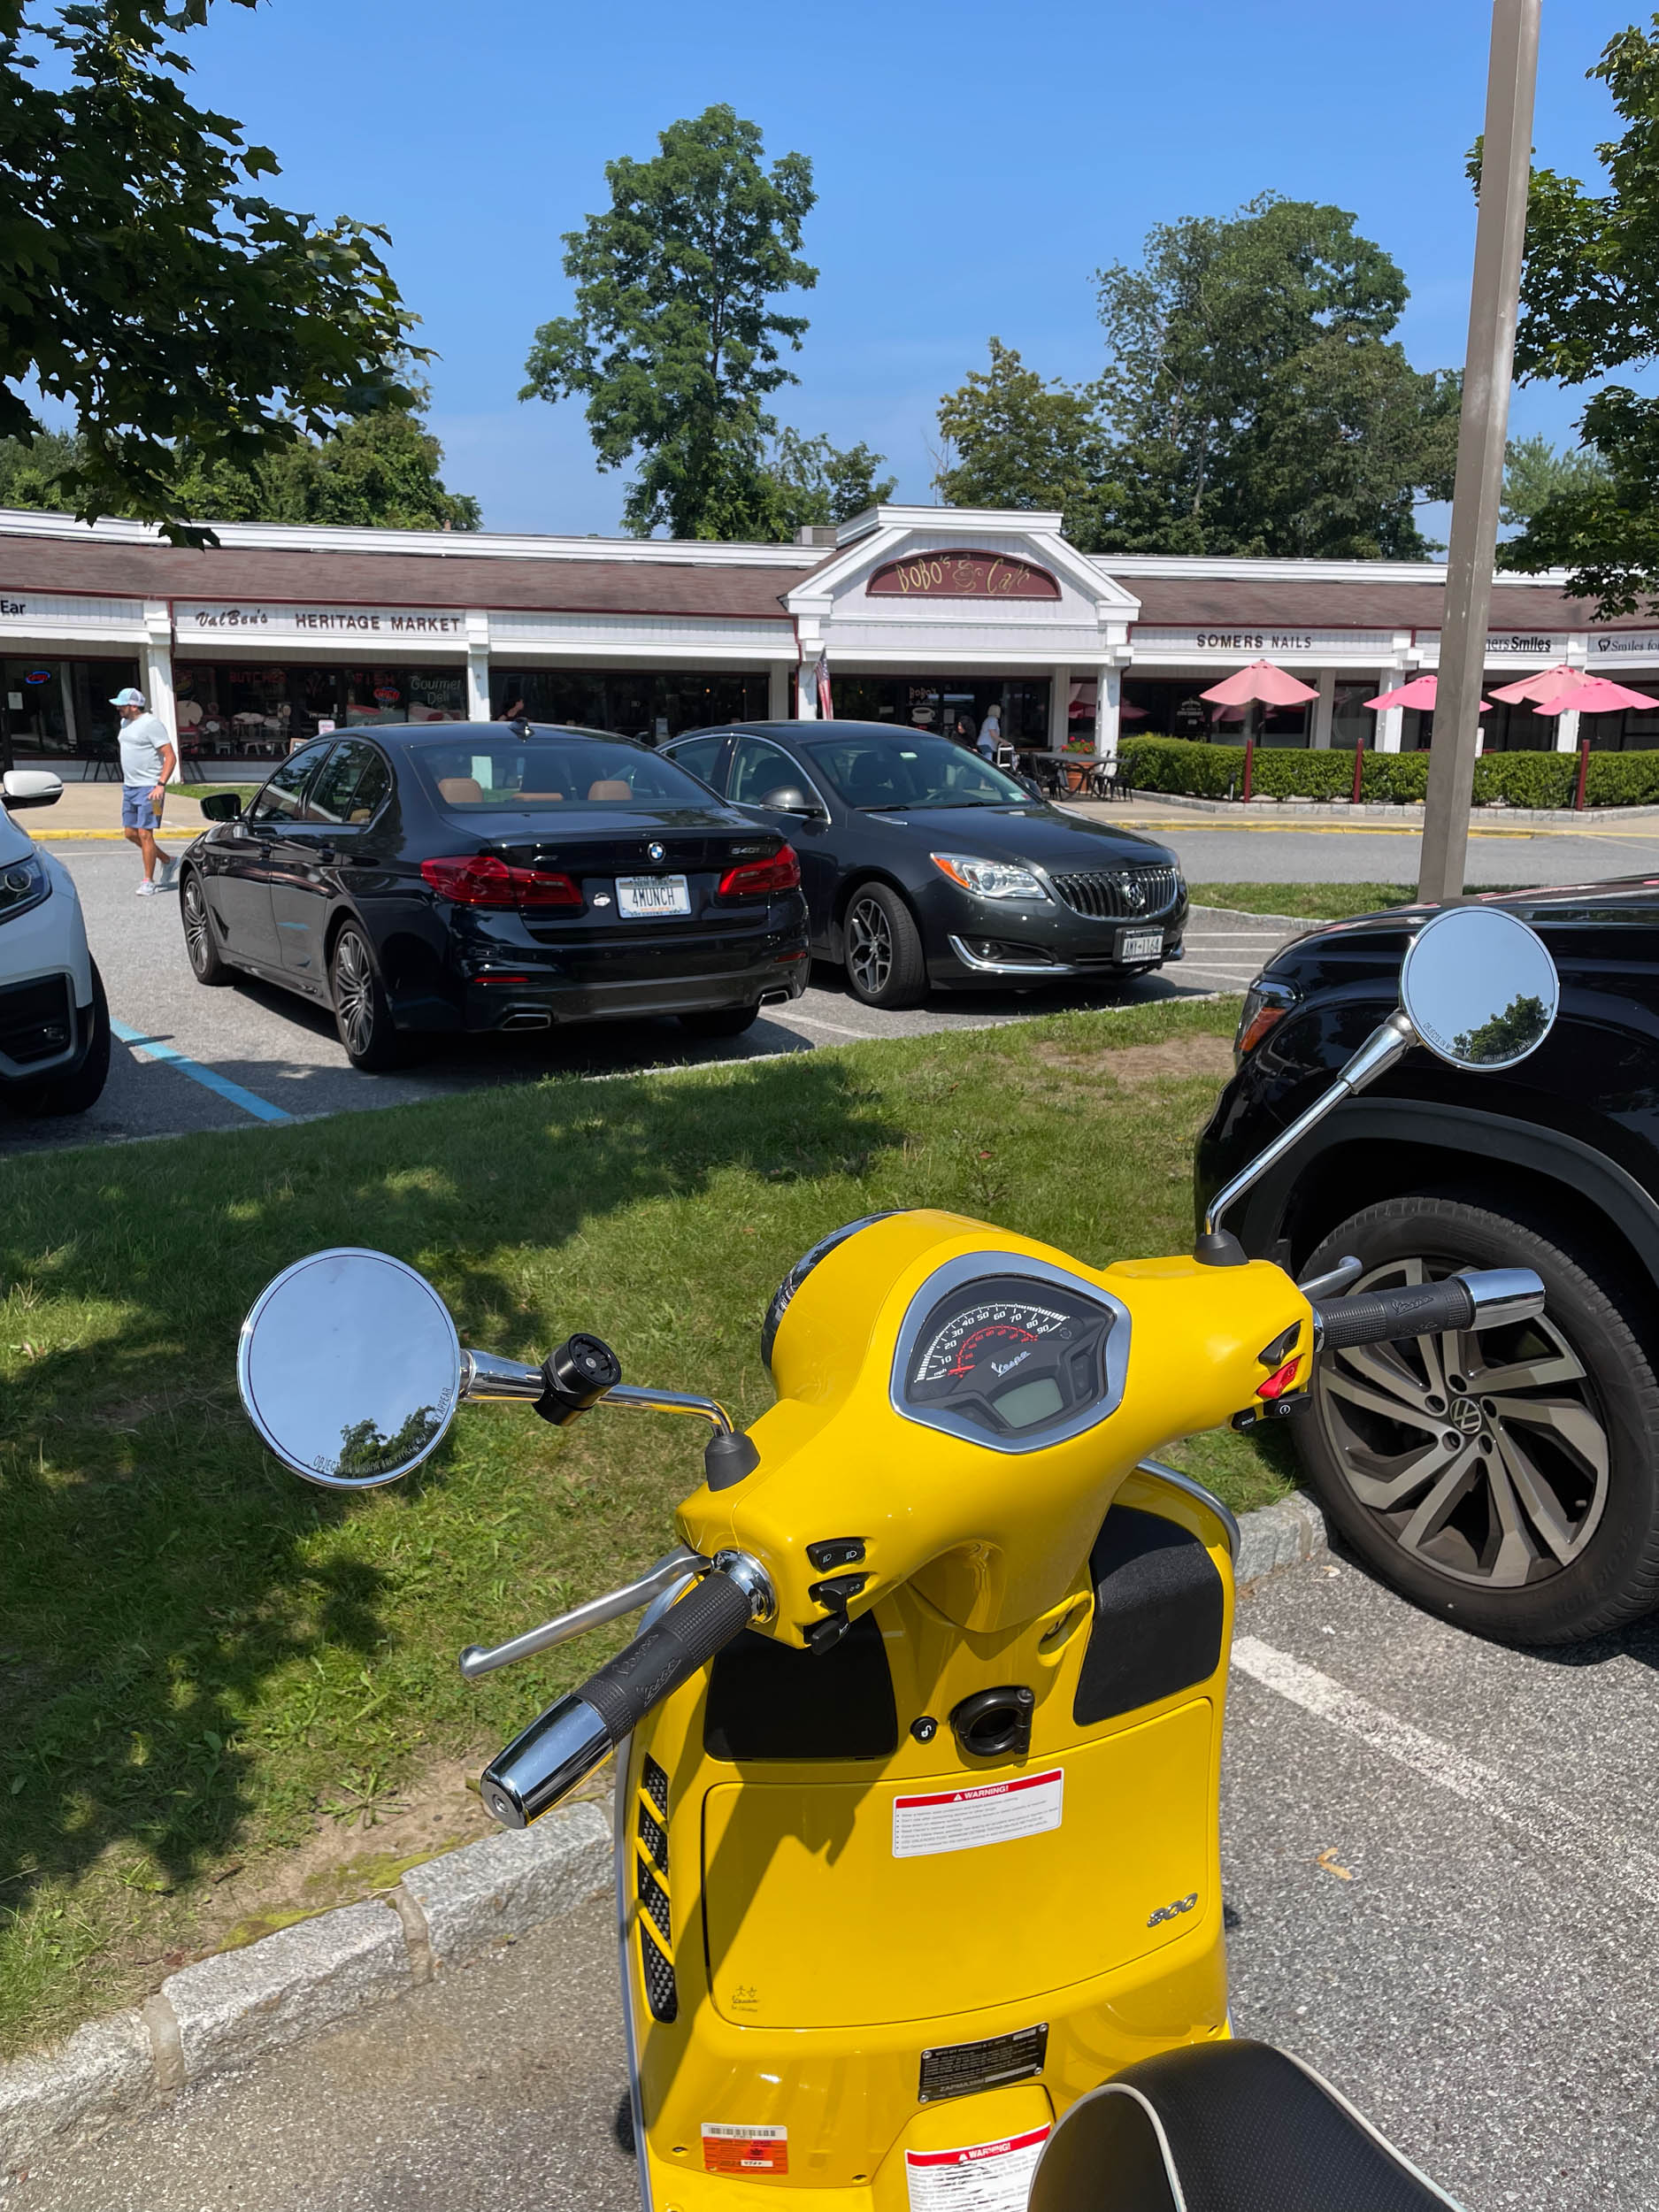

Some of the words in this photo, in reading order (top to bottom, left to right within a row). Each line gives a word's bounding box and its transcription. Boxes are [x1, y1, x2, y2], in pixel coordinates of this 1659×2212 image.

[1, 600, 26, 614] Ear
[295, 613, 380, 630] HERITAGE
[391, 616, 460, 632] MARKET
[1197, 634, 1263, 649] SOMERS
[1271, 636, 1312, 649] NAILS
[1611, 640, 1643, 651] Smiles
[1647, 638, 1659, 650] fo
[411, 677, 461, 690] Gourmet
[427, 692, 450, 705] Deli
[633, 887, 675, 908] 4MUNCH
[962, 1317, 975, 1326] 40
[977, 1311, 989, 1321] 50
[994, 1310, 1006, 1320] 60
[1010, 1313, 1022, 1323] 70
[1025, 1319, 1039, 1329] 80
[1036, 1325, 1049, 1334] 90
[951, 1328, 964, 1338] 30
[944, 1340, 957, 1350] 20
[941, 1356, 952, 1365] 10
[991, 1351, 1032, 1378] Vespa
[933, 1368, 948, 1377] mph
[435, 1386, 452, 1416] APPEAR
[964, 1785, 1010, 1800] WARNING!
[1147, 1893, 1198, 1928] 300
[969, 2142, 1011, 2160] WARNING!
